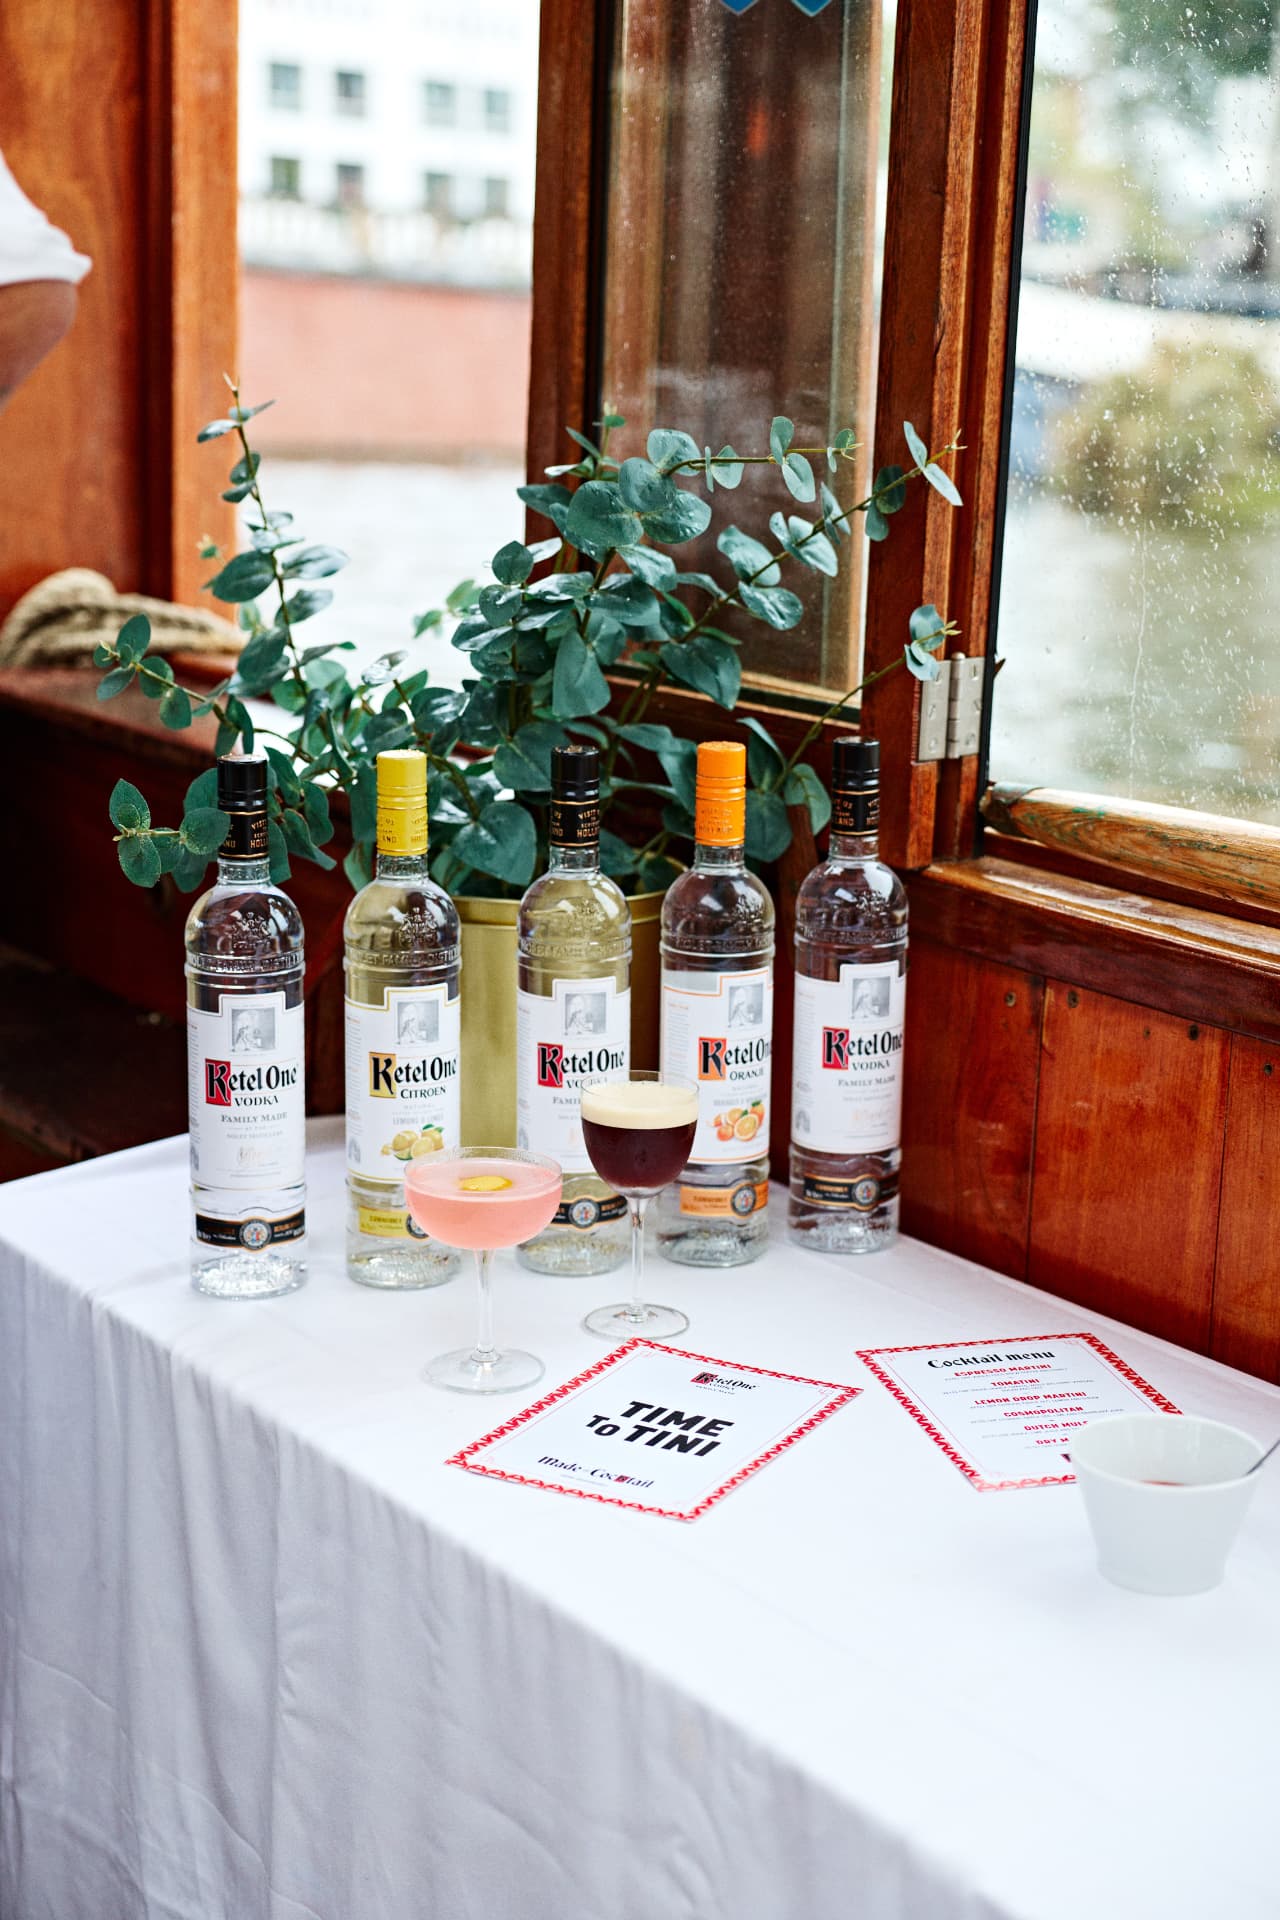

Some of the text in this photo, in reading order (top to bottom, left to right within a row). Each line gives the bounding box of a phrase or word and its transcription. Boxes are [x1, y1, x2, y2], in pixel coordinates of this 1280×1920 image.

[825, 1030, 878, 1067] Ketel
[539, 1046, 625, 1085] Ketel One
[702, 1040, 753, 1077] Ketel
[852, 1060, 890, 1071] VODKA
[206, 1062, 297, 1103] Ketel One
[371, 1055, 457, 1095] Ketel One
[400, 1087, 446, 1099] CITROEN
[234, 1095, 279, 1107] VODKA
[220, 1112, 288, 1124] FAMILY MADE
[927, 1351, 1056, 1369] Cocktail menu
[954, 1367, 1007, 1377] ESPRESSO
[1008, 1363, 1052, 1372] MARTINI
[991, 1378, 1041, 1387] TOMATINI
[974, 1397, 1011, 1406] LEMON
[1012, 1394, 1041, 1402] DROP
[1043, 1391, 1088, 1400] MARTINI
[620, 1400, 735, 1432] TIME
[1003, 1406, 1084, 1417] COSMOPOLITAN
[1023, 1423, 1060, 1431] DUTCH
[624, 1424, 721, 1456] TINI
[537, 1456, 582, 1472] Made
